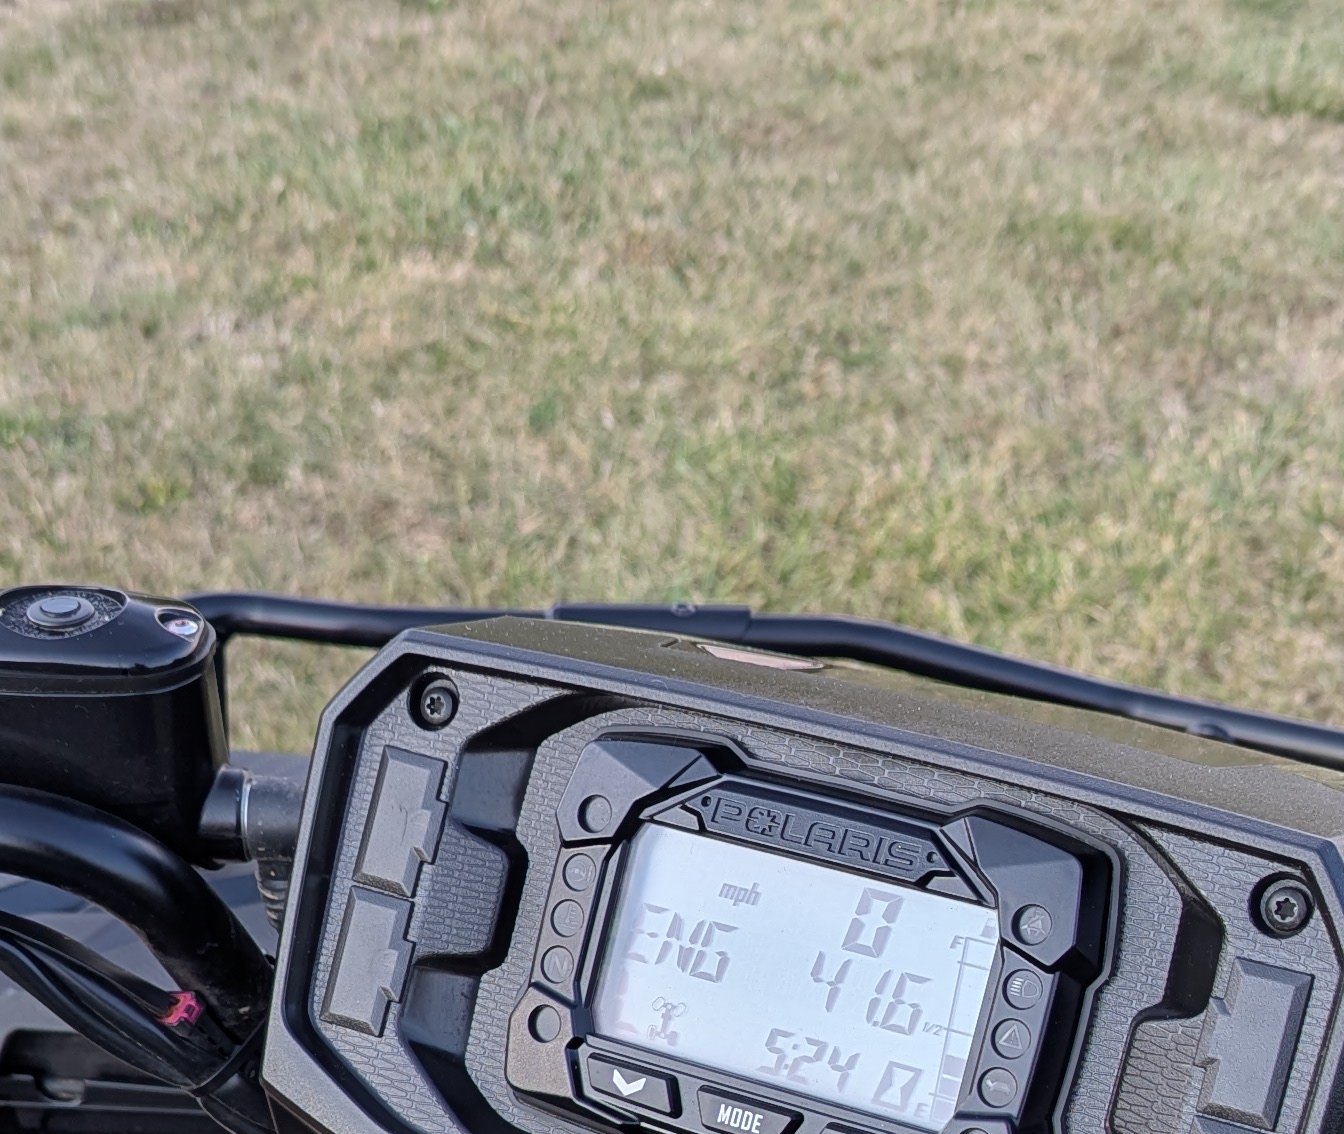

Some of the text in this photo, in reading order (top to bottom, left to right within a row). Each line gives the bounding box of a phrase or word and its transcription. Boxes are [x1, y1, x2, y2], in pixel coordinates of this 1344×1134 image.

[711, 797, 922, 871] POLARIS
[718, 882, 762, 906] mph
[842, 886, 904, 958] 0
[717, 1103, 764, 1134] MODE
